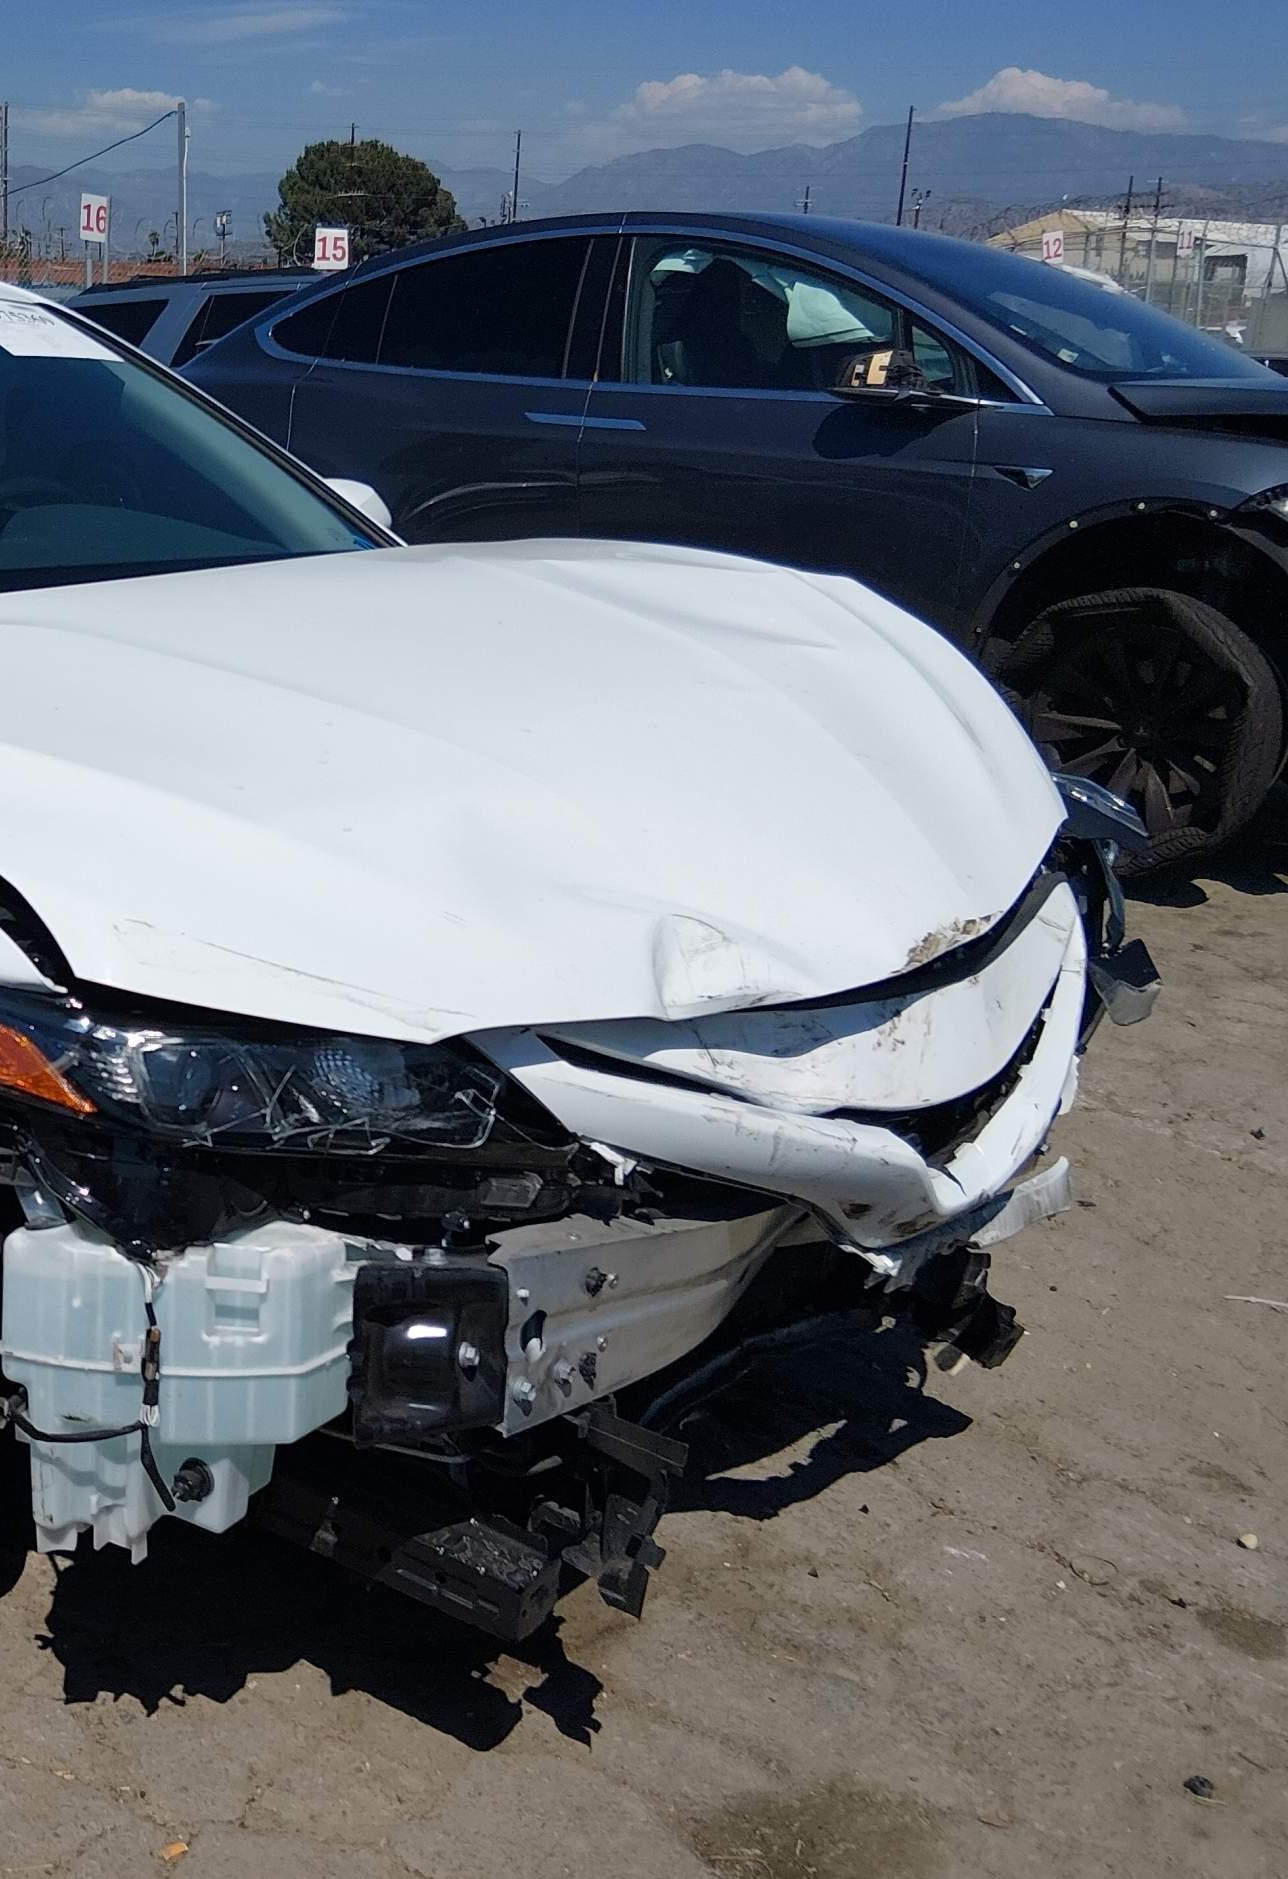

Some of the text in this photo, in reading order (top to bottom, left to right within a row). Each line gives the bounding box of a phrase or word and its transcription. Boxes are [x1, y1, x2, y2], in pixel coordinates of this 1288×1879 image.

[82, 204, 106, 234] 16
[317, 236, 346, 262] 15
[1044, 238, 1062, 260] 12
